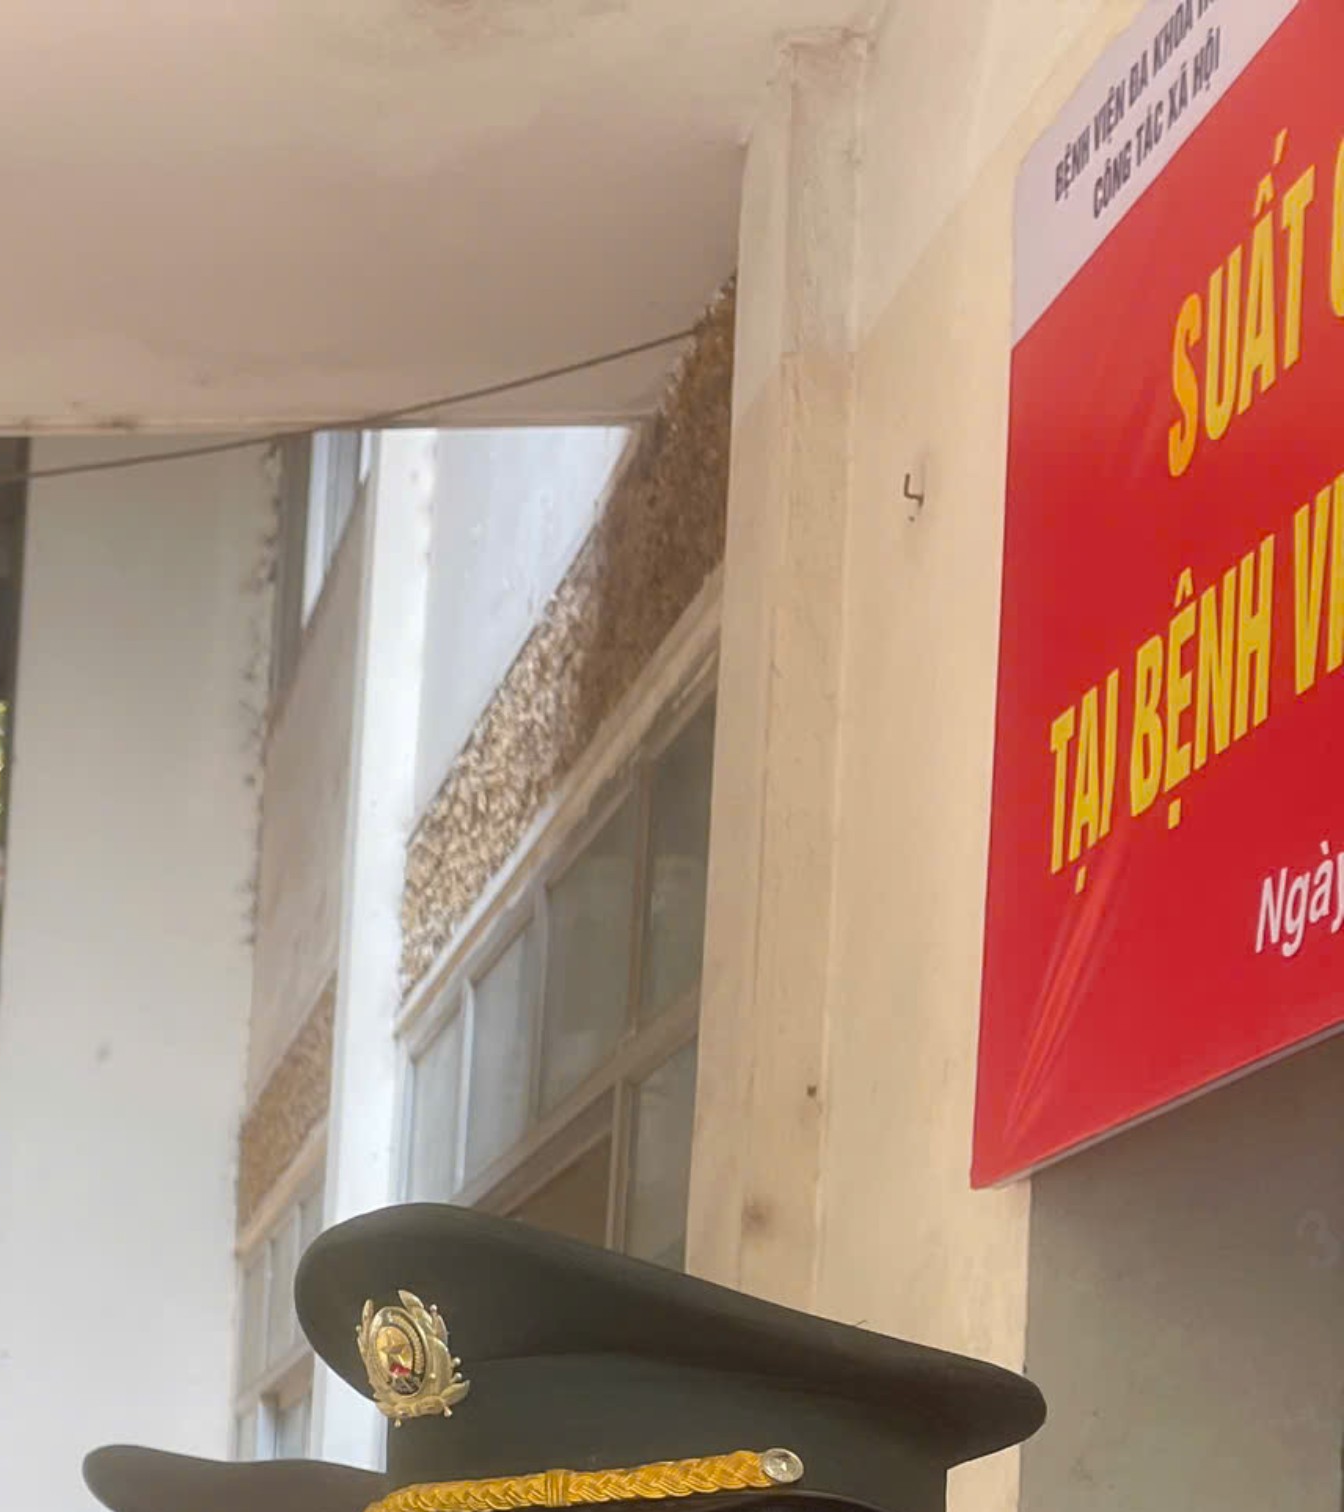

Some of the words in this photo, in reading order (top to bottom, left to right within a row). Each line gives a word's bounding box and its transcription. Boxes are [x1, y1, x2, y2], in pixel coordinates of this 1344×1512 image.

[1055, 124, 1090, 202] BỆNH
[1093, 79, 1126, 151] VIỆN
[1129, 49, 1148, 108] ĐA
[1093, 139, 1132, 219] CÔNG
[1136, 100, 1163, 167] TÁC
[1193, 26, 1221, 98] HỘI
[1168, 127, 1315, 478] SUẤT
[1050, 667, 1119, 894] TẠI
[1130, 533, 1275, 830] BỆNH
